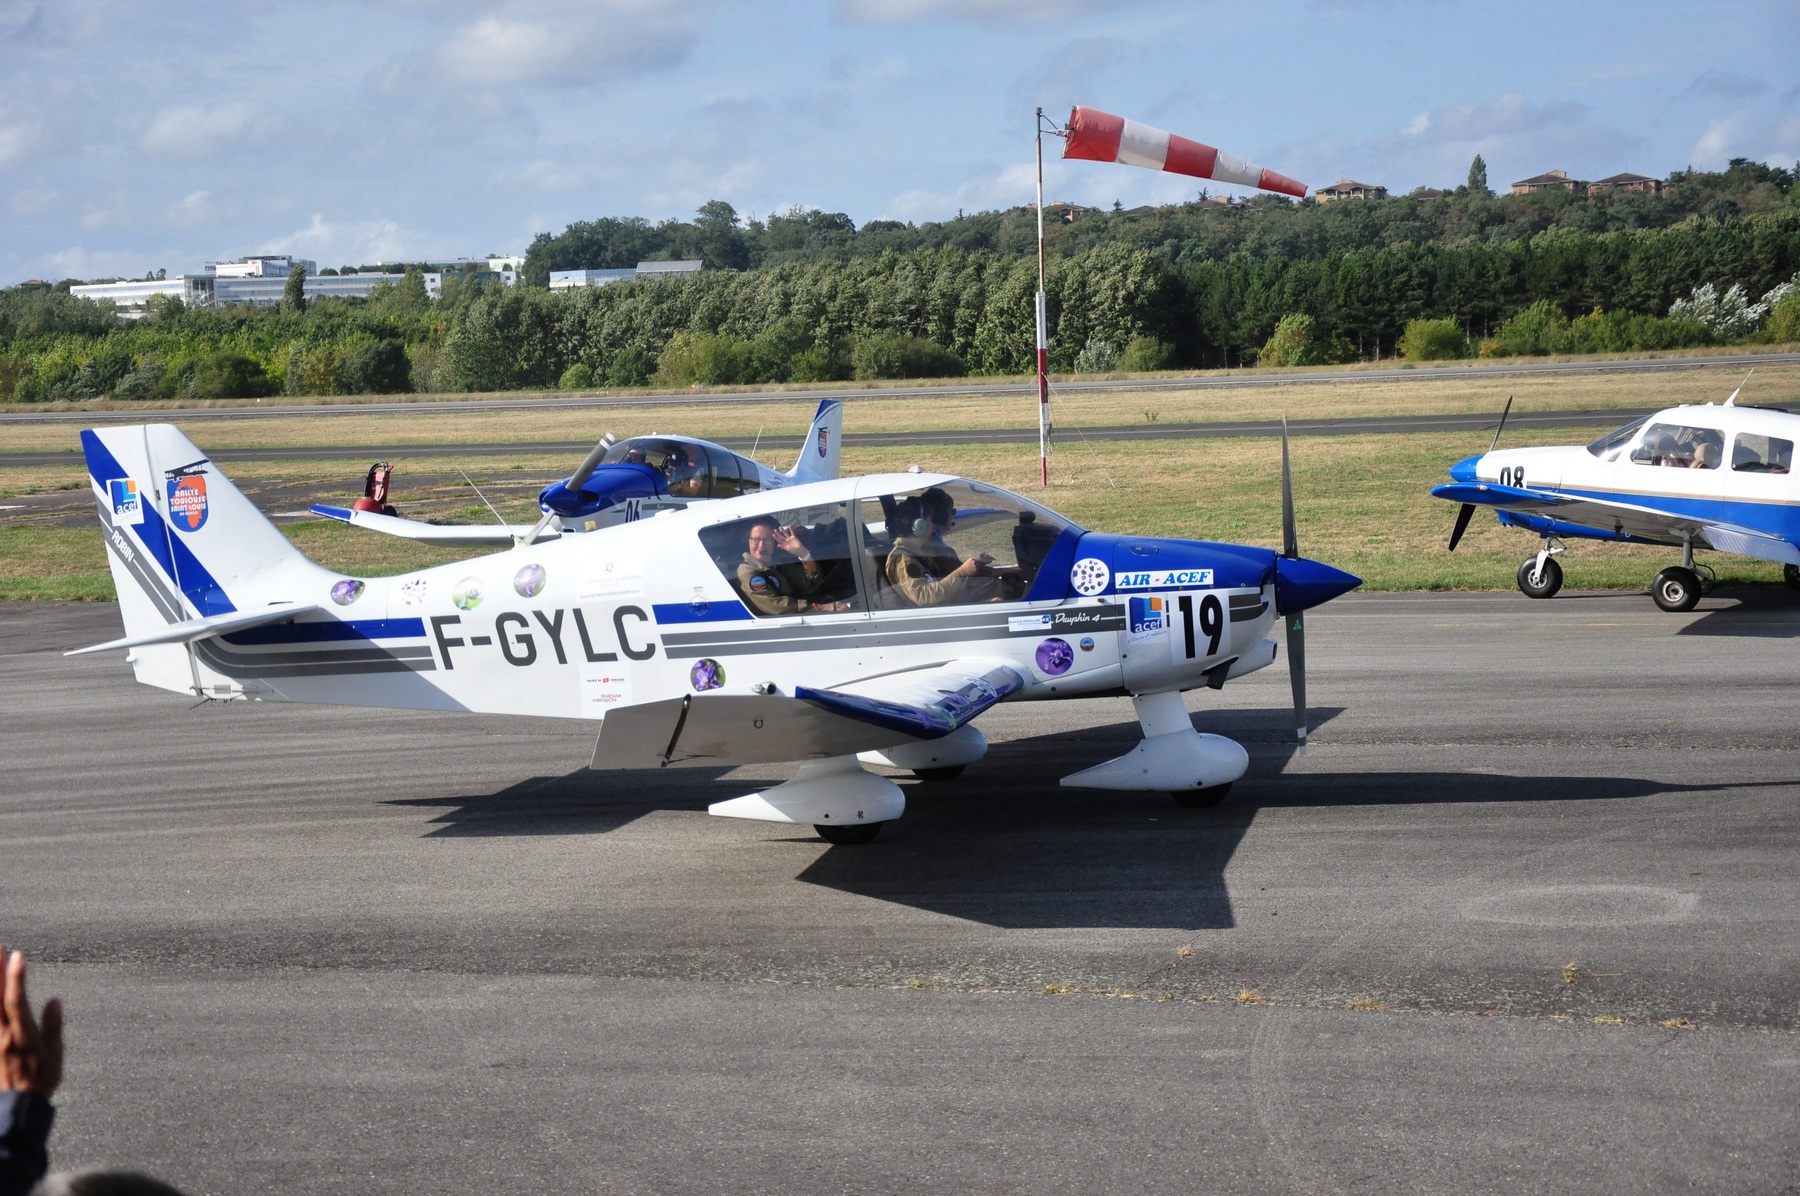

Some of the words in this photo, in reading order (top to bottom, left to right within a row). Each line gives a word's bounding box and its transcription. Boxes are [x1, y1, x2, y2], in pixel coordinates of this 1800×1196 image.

[170, 495, 206, 505] TOULOUSE
[175, 488, 199, 498] RALLYE
[116, 500, 138, 515] acef
[170, 503, 207, 513] SAINT-LOUIS
[111, 530, 135, 562] ROBIN
[1118, 574, 1151, 587] AIR
[1163, 571, 1211, 584] ACEF
[1055, 612, 1090, 626] Dauphin
[1092, 614, 1101, 622] 4
[1135, 618, 1162, 633] acef
[1178, 594, 1224, 659] 19
[430, 604, 656, 670] F-GYLC
